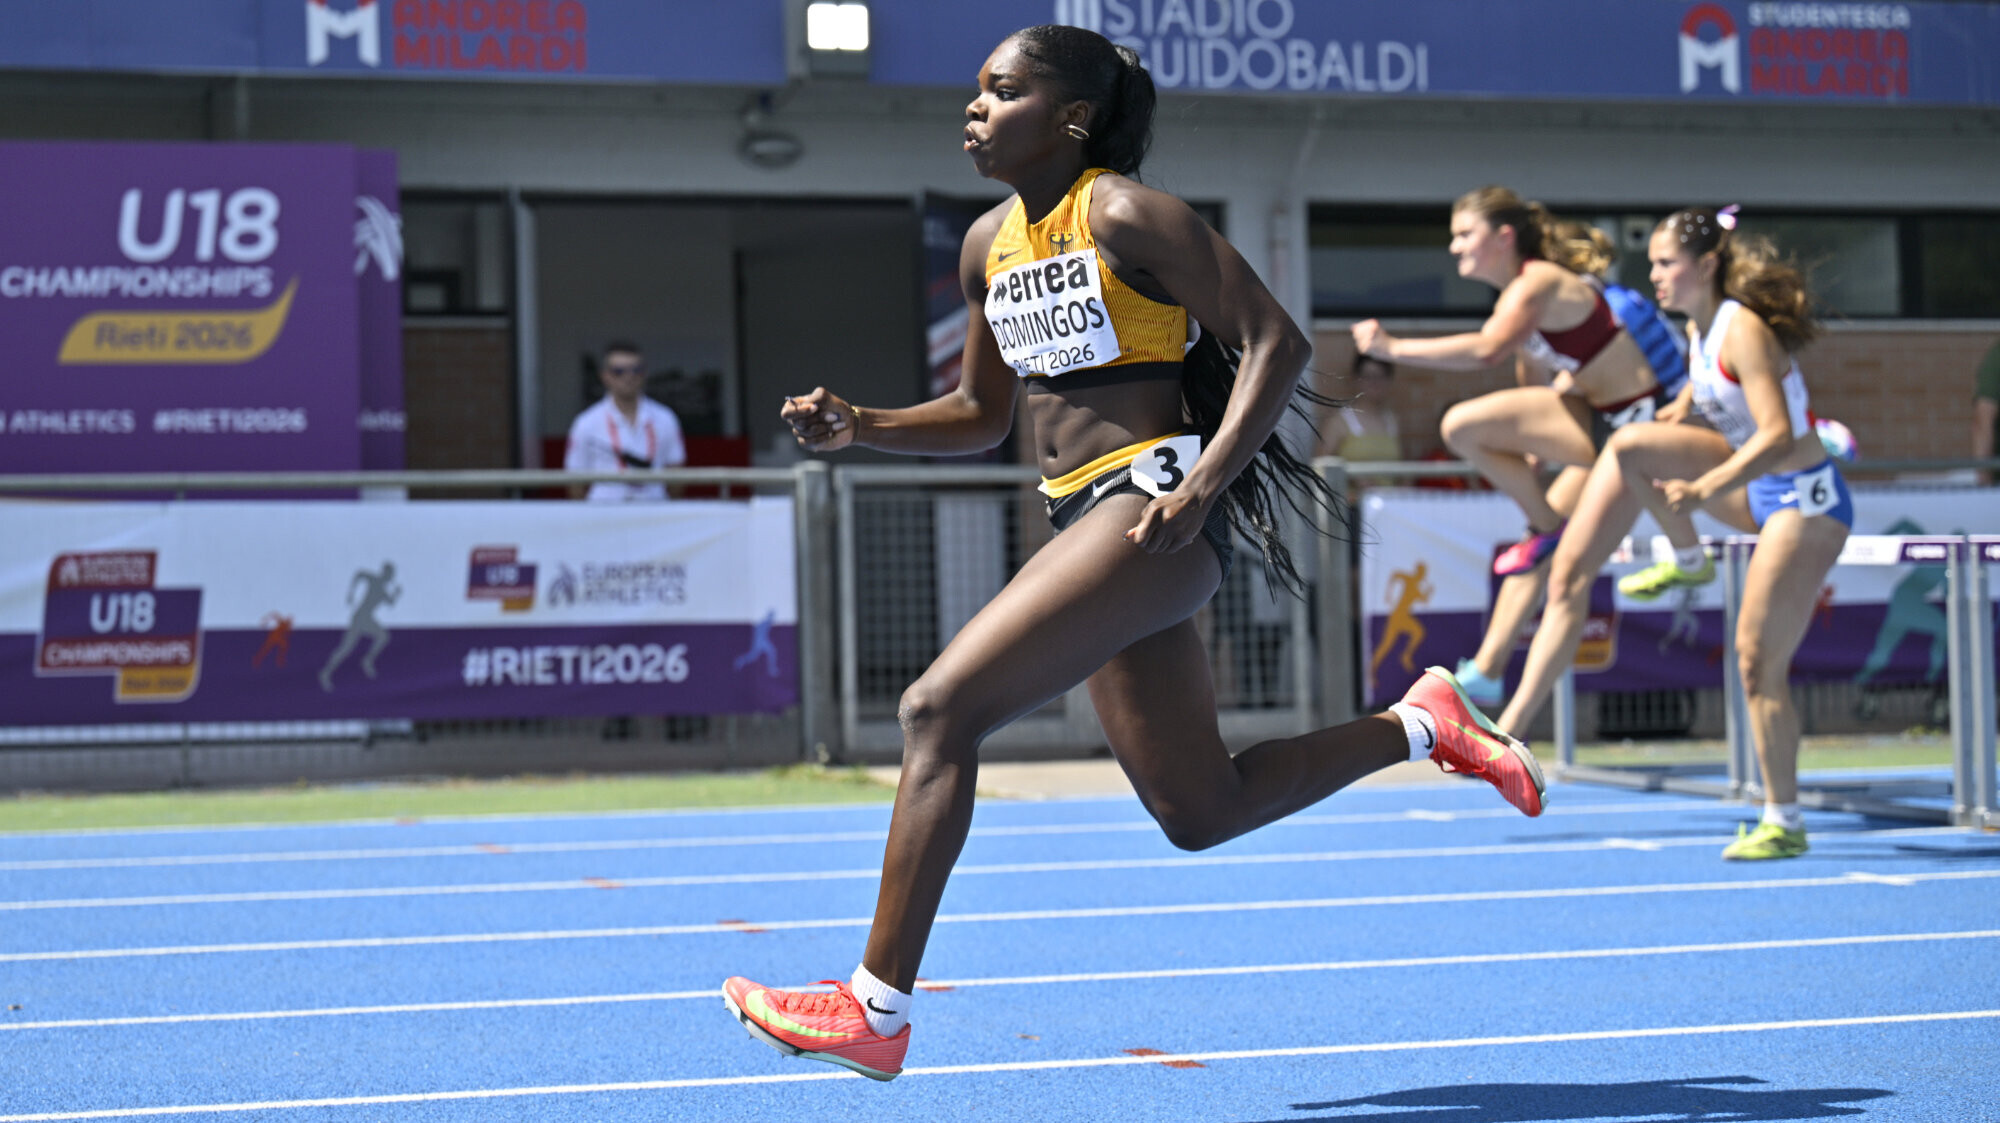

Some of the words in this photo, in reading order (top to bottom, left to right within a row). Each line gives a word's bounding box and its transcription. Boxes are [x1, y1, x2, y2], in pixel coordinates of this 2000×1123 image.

[392, 0, 587, 34] ANDREA
[1104, 0, 1294, 39] STADIO
[1749, 4, 1910, 29] STUDENTESCA
[393, 35, 587, 72] MILARDI
[1751, 28, 1909, 60] ANDREA
[1751, 63, 1909, 97] MILARDI
[118, 187, 280, 264] U18
[1, 266, 273, 298] CHAMPIONSHIPS
[95, 321, 167, 351] Rieti
[174, 321, 254, 351] 2026
[991, 296, 1105, 351] DOMINGOS
[1048, 343, 1096, 370] 2026
[10, 410, 136, 434] ATHLETICS
[153, 408, 308, 434] #RIETI2026
[1154, 446, 1184, 491] 3
[1810, 477, 1828, 506] 6
[582, 562, 687, 580] EUROPEAN
[582, 586, 687, 605] ATHLETICS
[90, 591, 156, 634] U18
[45, 641, 191, 666] CHAMPIONSHIPS
[463, 644, 689, 686] #RIETI2026
